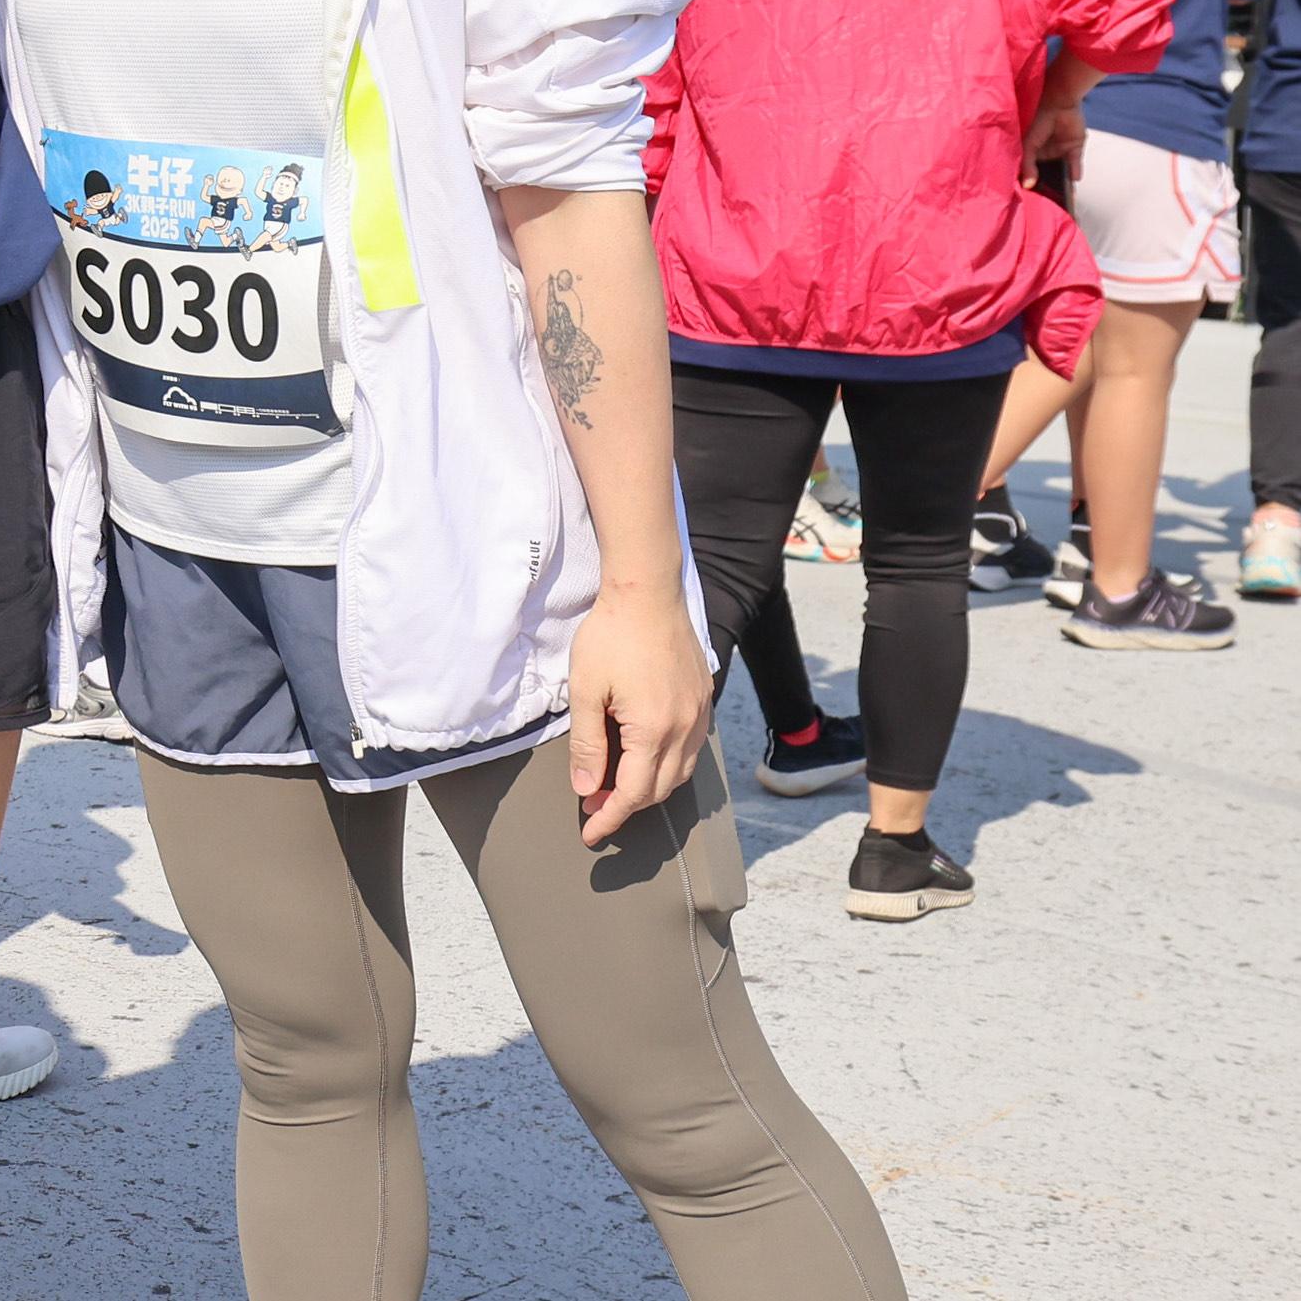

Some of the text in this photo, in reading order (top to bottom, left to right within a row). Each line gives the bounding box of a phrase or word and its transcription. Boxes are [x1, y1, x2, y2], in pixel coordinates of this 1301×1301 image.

[127, 154, 195, 197] 牛仔
[140, 214, 179, 240] 2025
[75, 247, 279, 362] S030
